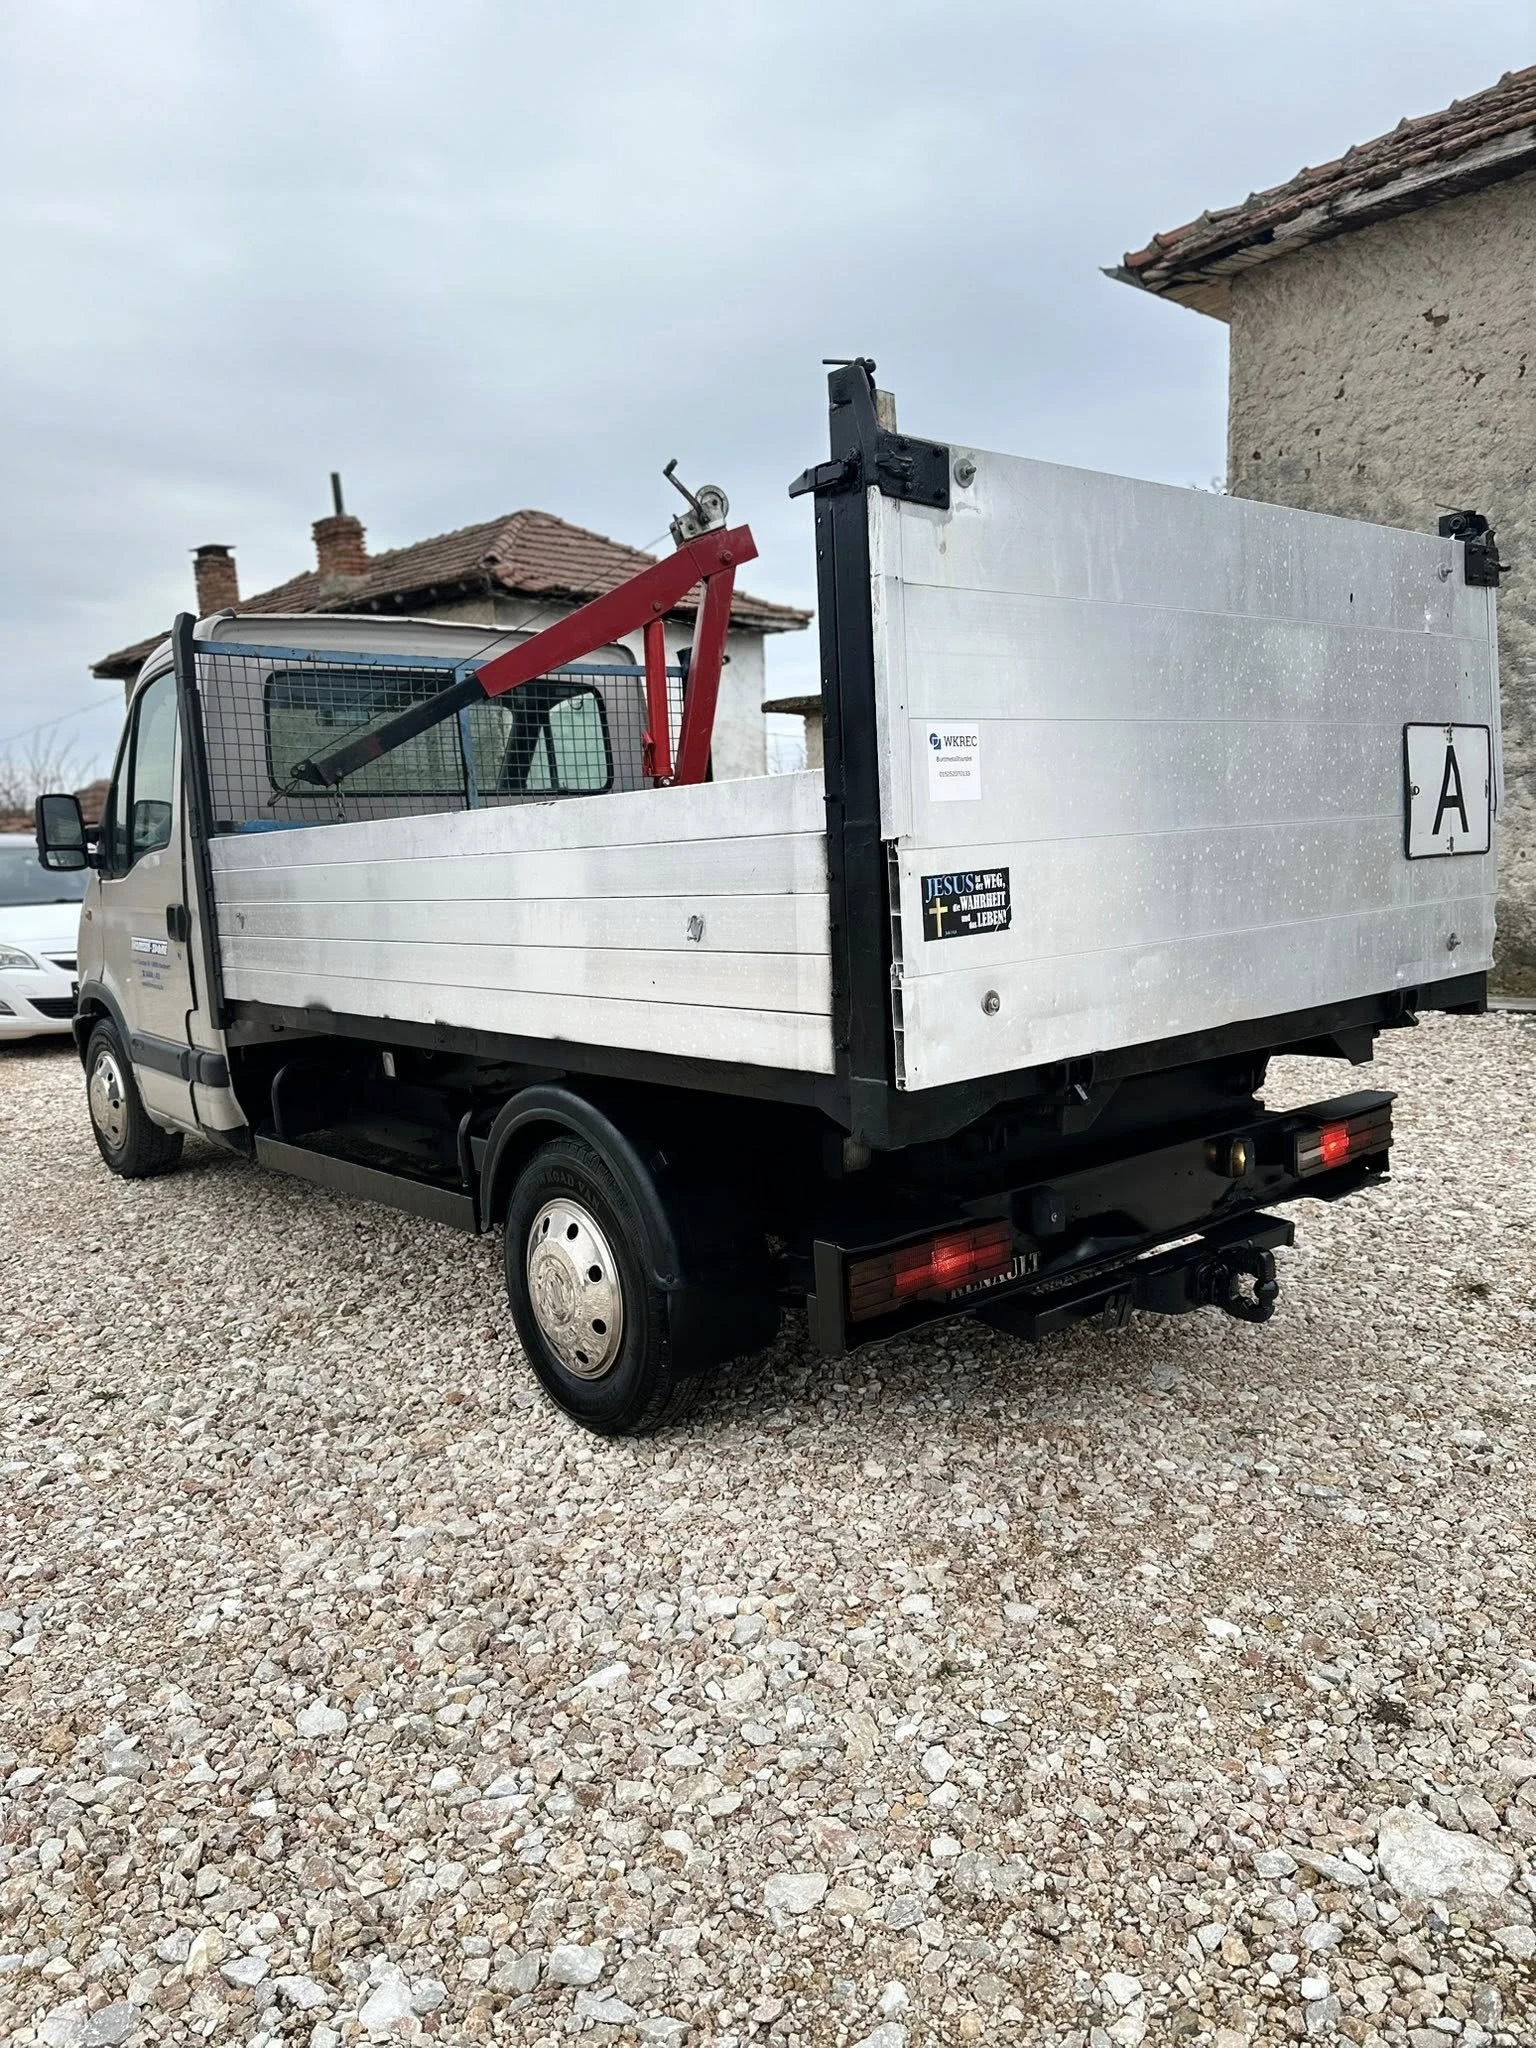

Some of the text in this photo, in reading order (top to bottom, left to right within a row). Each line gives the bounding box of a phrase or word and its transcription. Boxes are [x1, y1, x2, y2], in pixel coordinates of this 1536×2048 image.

[943, 735, 978, 747] WKREC
[1432, 745, 1469, 835] A
[925, 873, 974, 903] JESUS
[983, 873, 1006, 889] WEG,
[959, 891, 1006, 911] WAHRHEIT
[977, 909, 1007, 928] LEBEN!
